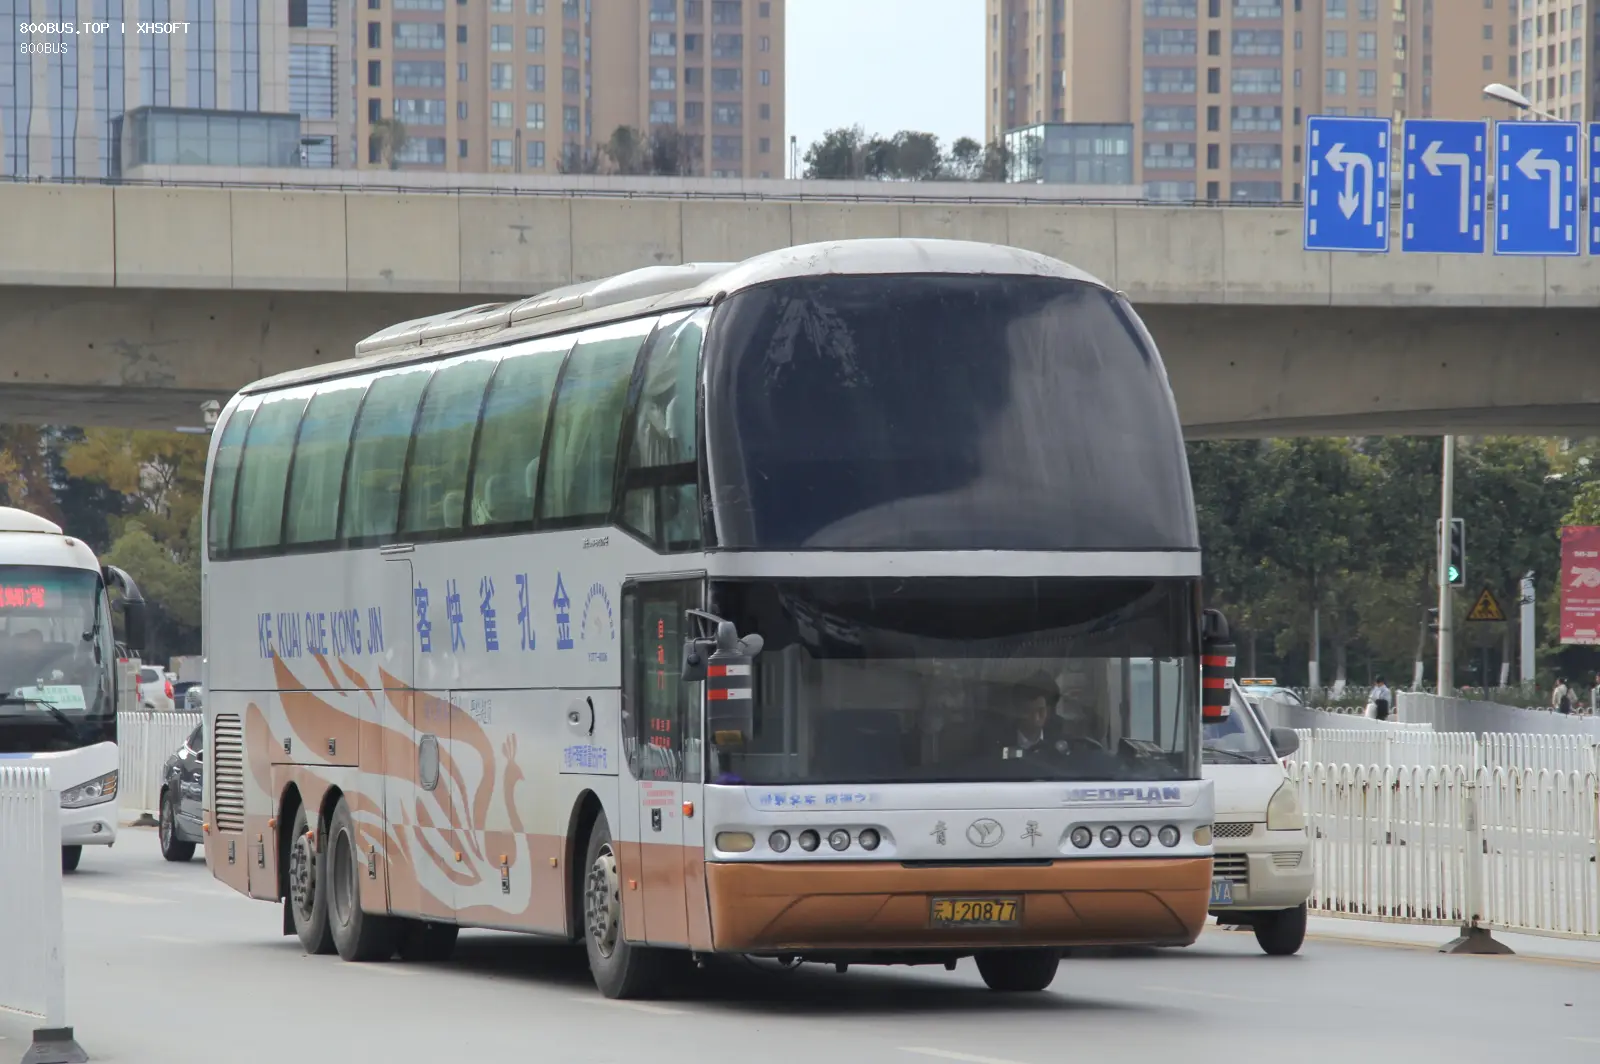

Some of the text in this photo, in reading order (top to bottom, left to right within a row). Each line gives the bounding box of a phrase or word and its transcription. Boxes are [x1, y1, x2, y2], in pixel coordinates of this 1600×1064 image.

[257, 606, 384, 658] KE KUAI QUE KONG JIN
